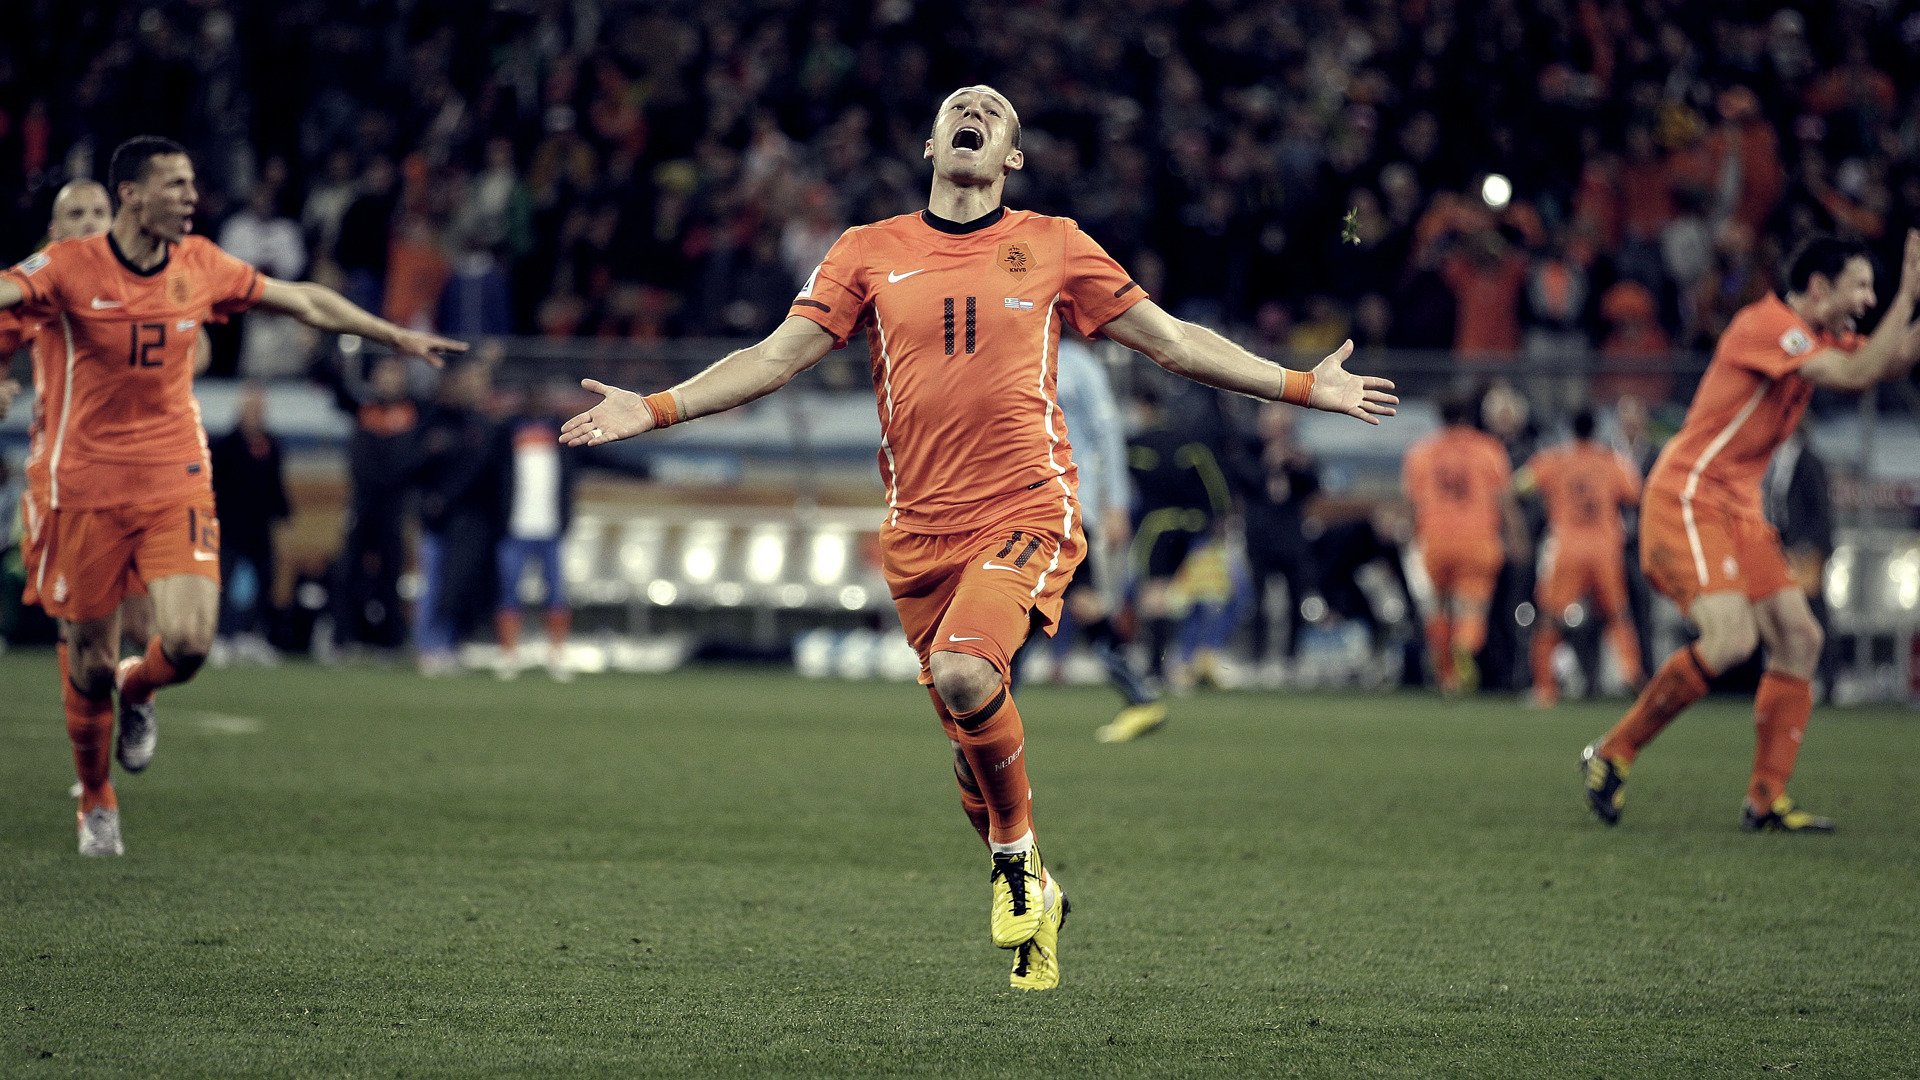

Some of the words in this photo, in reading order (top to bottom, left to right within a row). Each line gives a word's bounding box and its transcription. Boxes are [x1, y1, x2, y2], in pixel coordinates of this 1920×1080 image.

[130, 323, 165, 367] 12
[943, 296, 976, 355] 11
[994, 737, 1025, 772] NEDER
